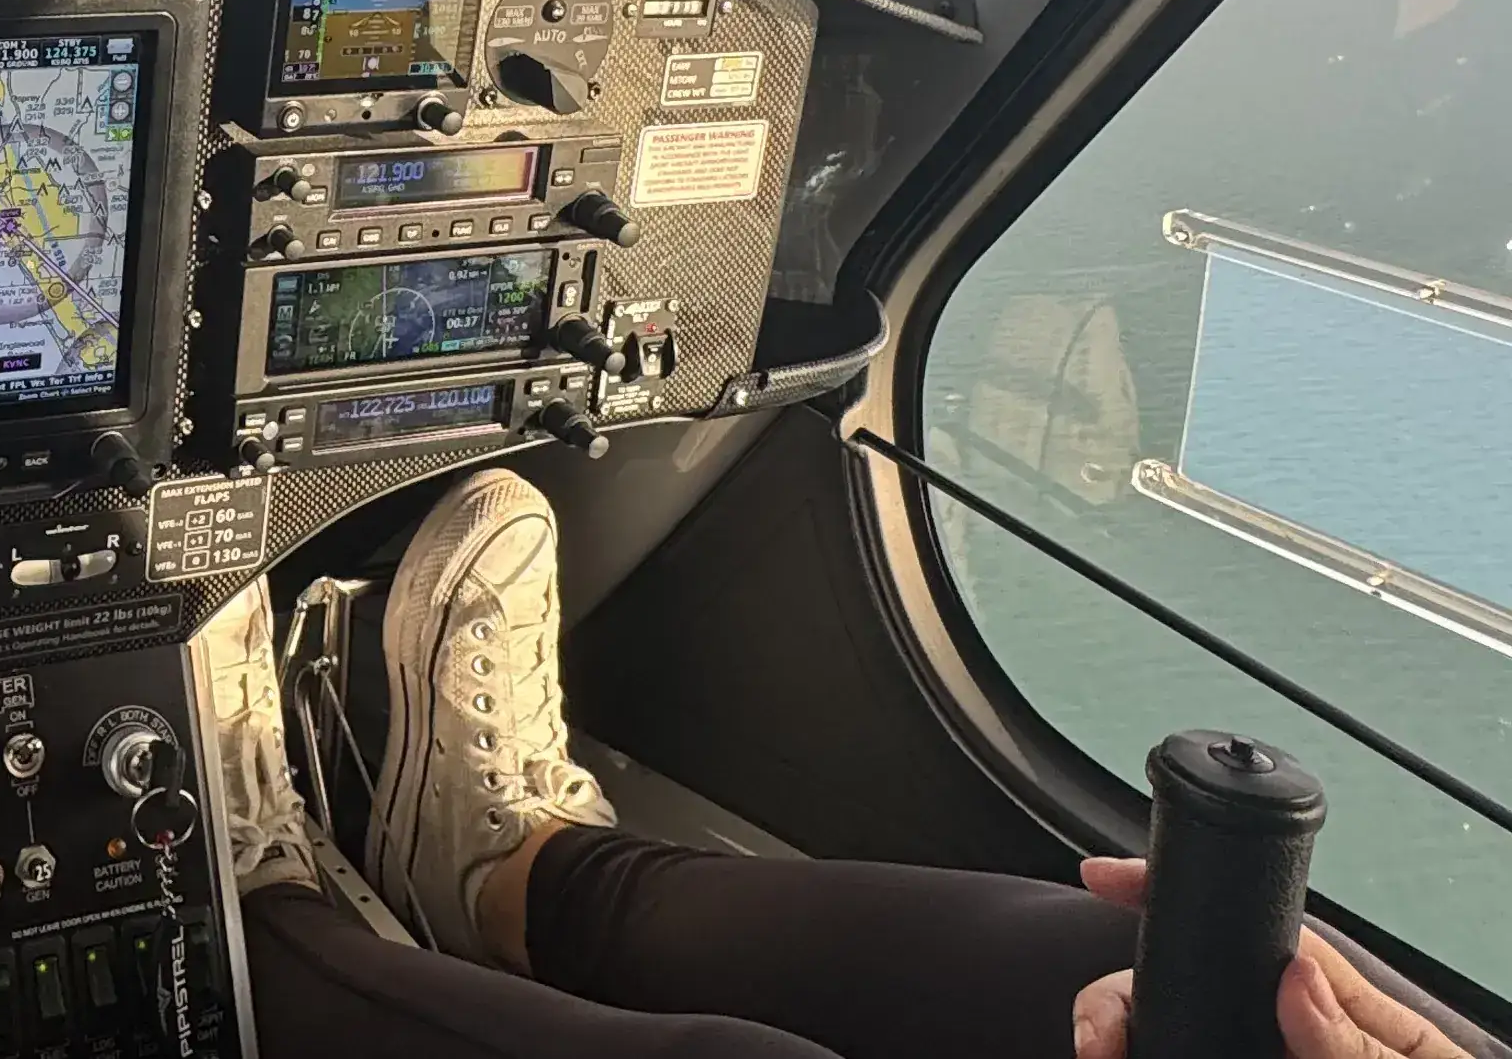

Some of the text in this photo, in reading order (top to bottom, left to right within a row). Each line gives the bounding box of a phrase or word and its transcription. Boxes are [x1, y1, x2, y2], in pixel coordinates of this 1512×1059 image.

[506, 8, 525, 18] MAX
[58, 39, 82, 47] STBY
[533, 29, 567, 44] AUTO
[45, 45, 97, 59] 124.375
[667, 88, 691, 99] CREW
[652, 130, 755, 144] PASSENGER WARNING
[356, 161, 425, 184] 121.900
[452, 225, 472, 235] FUNC
[498, 292, 524, 304] 1200
[2, 359, 30, 369] KVNC
[10, 381, 27, 390] FPL
[25, 457, 48, 467] BACK
[161, 477, 262, 498] MAX EXTENSION SPEED
[194, 491, 230, 506] FLAPS
[216, 508, 236, 523] 60
[214, 528, 234, 543] 70
[213, 547, 241, 563] 130
[12, 619, 60, 637] WEIGHT
[63, 616, 89, 629] limit
[93, 612, 110, 625] 22
[113, 607, 133, 620] lbs
[136, 604, 172, 619] (10kg)
[3, 694, 26, 707] GEN
[10, 710, 26, 721] ON
[120, 710, 149, 723] BOTH
[17, 785, 38, 797] OFF
[35, 865, 52, 882] 25
[93, 858, 141, 879] BATTERY
[95, 873, 142, 892] CAUTION
[26, 889, 50, 903] GEN
[23, 913, 101, 937] NOT DOOR OPEN
[171, 925, 194, 1058] PIPISTREL
